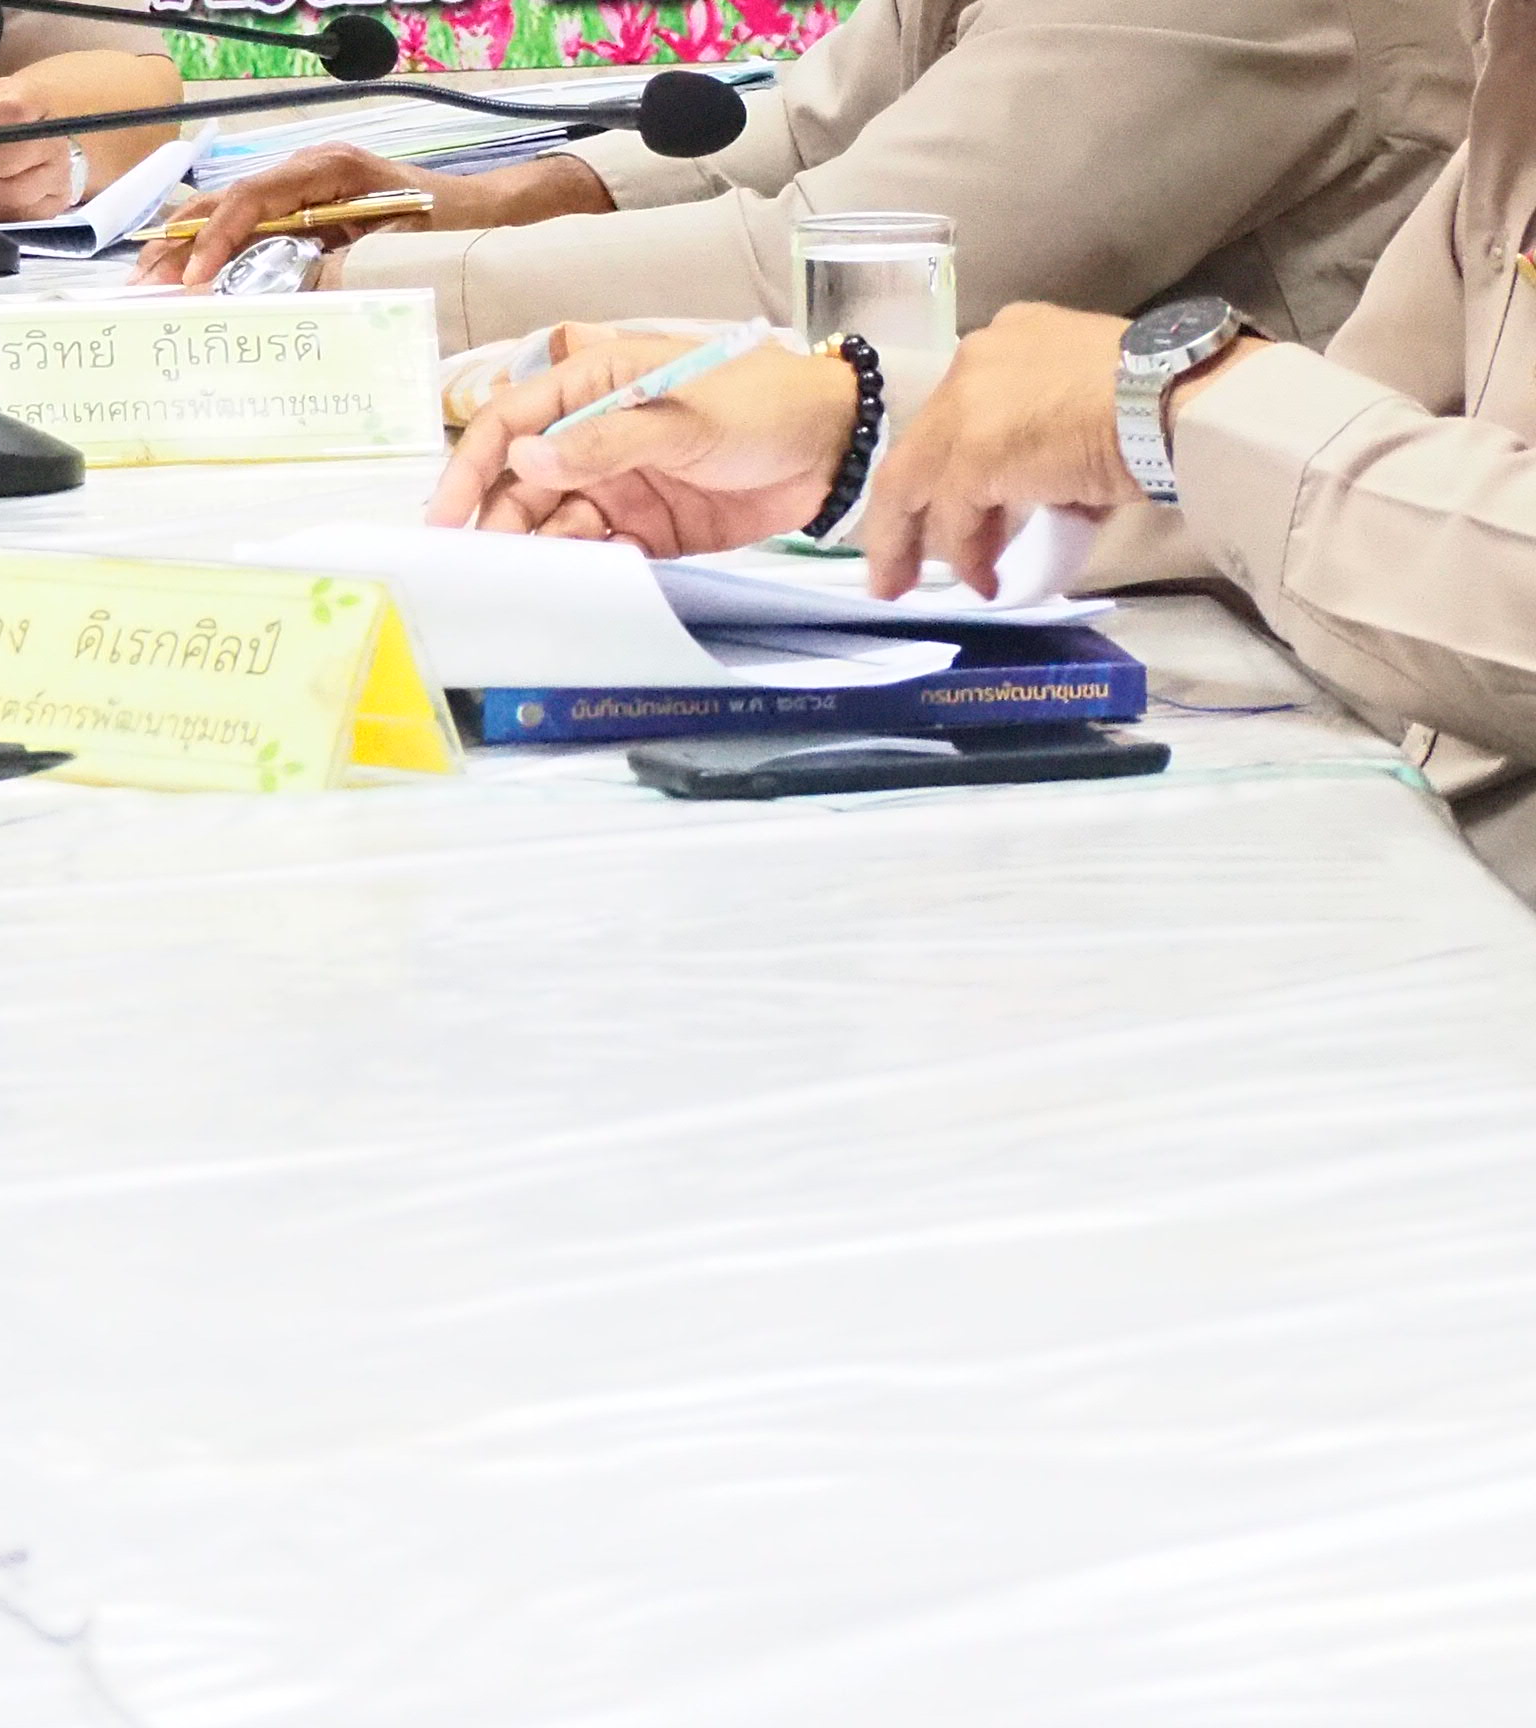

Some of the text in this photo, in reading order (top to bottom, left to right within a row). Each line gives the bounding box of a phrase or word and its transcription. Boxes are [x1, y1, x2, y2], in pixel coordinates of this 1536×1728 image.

[151, 320, 324, 383] กู้เกียรติ
[73, 608, 283, 678] ดิเรกศิลป์
